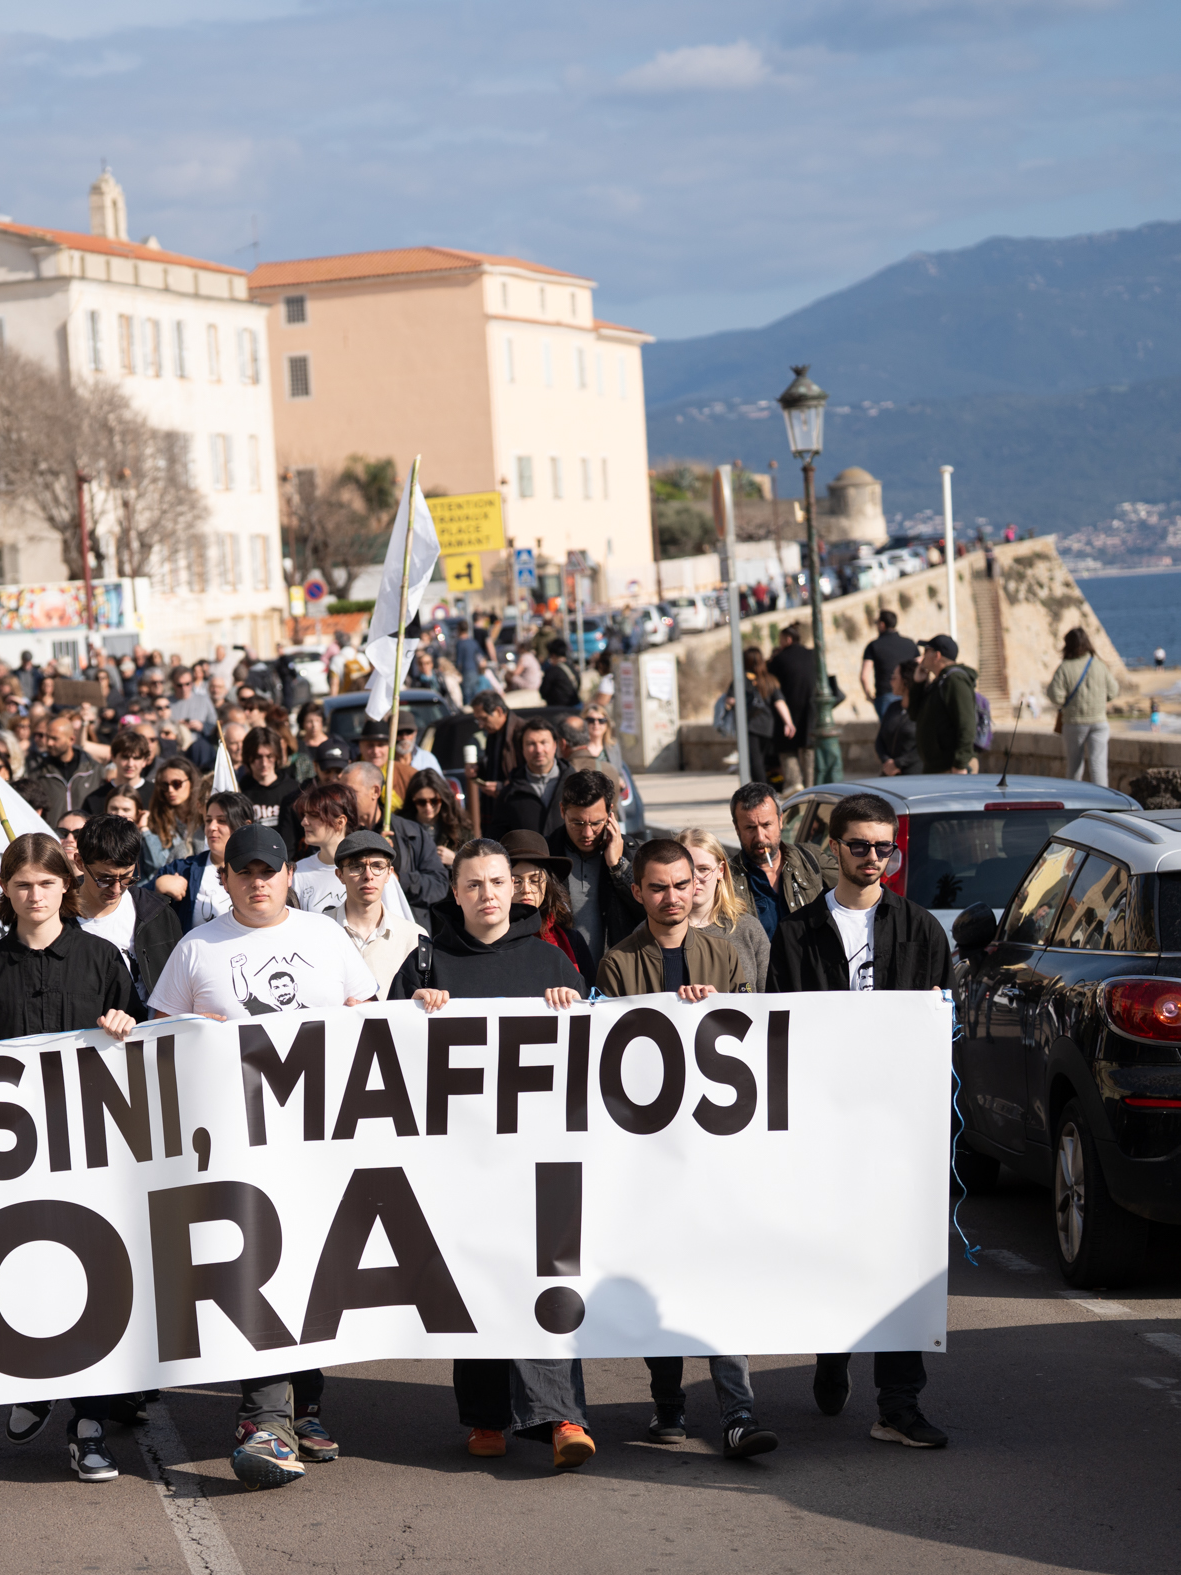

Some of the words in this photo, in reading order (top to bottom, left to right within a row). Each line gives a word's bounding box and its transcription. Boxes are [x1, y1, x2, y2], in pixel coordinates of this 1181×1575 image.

[439, 523, 482, 537] PLACE
[238, 1007, 790, 1146] MAFFIOSI
[533, 1161, 586, 1335] !
